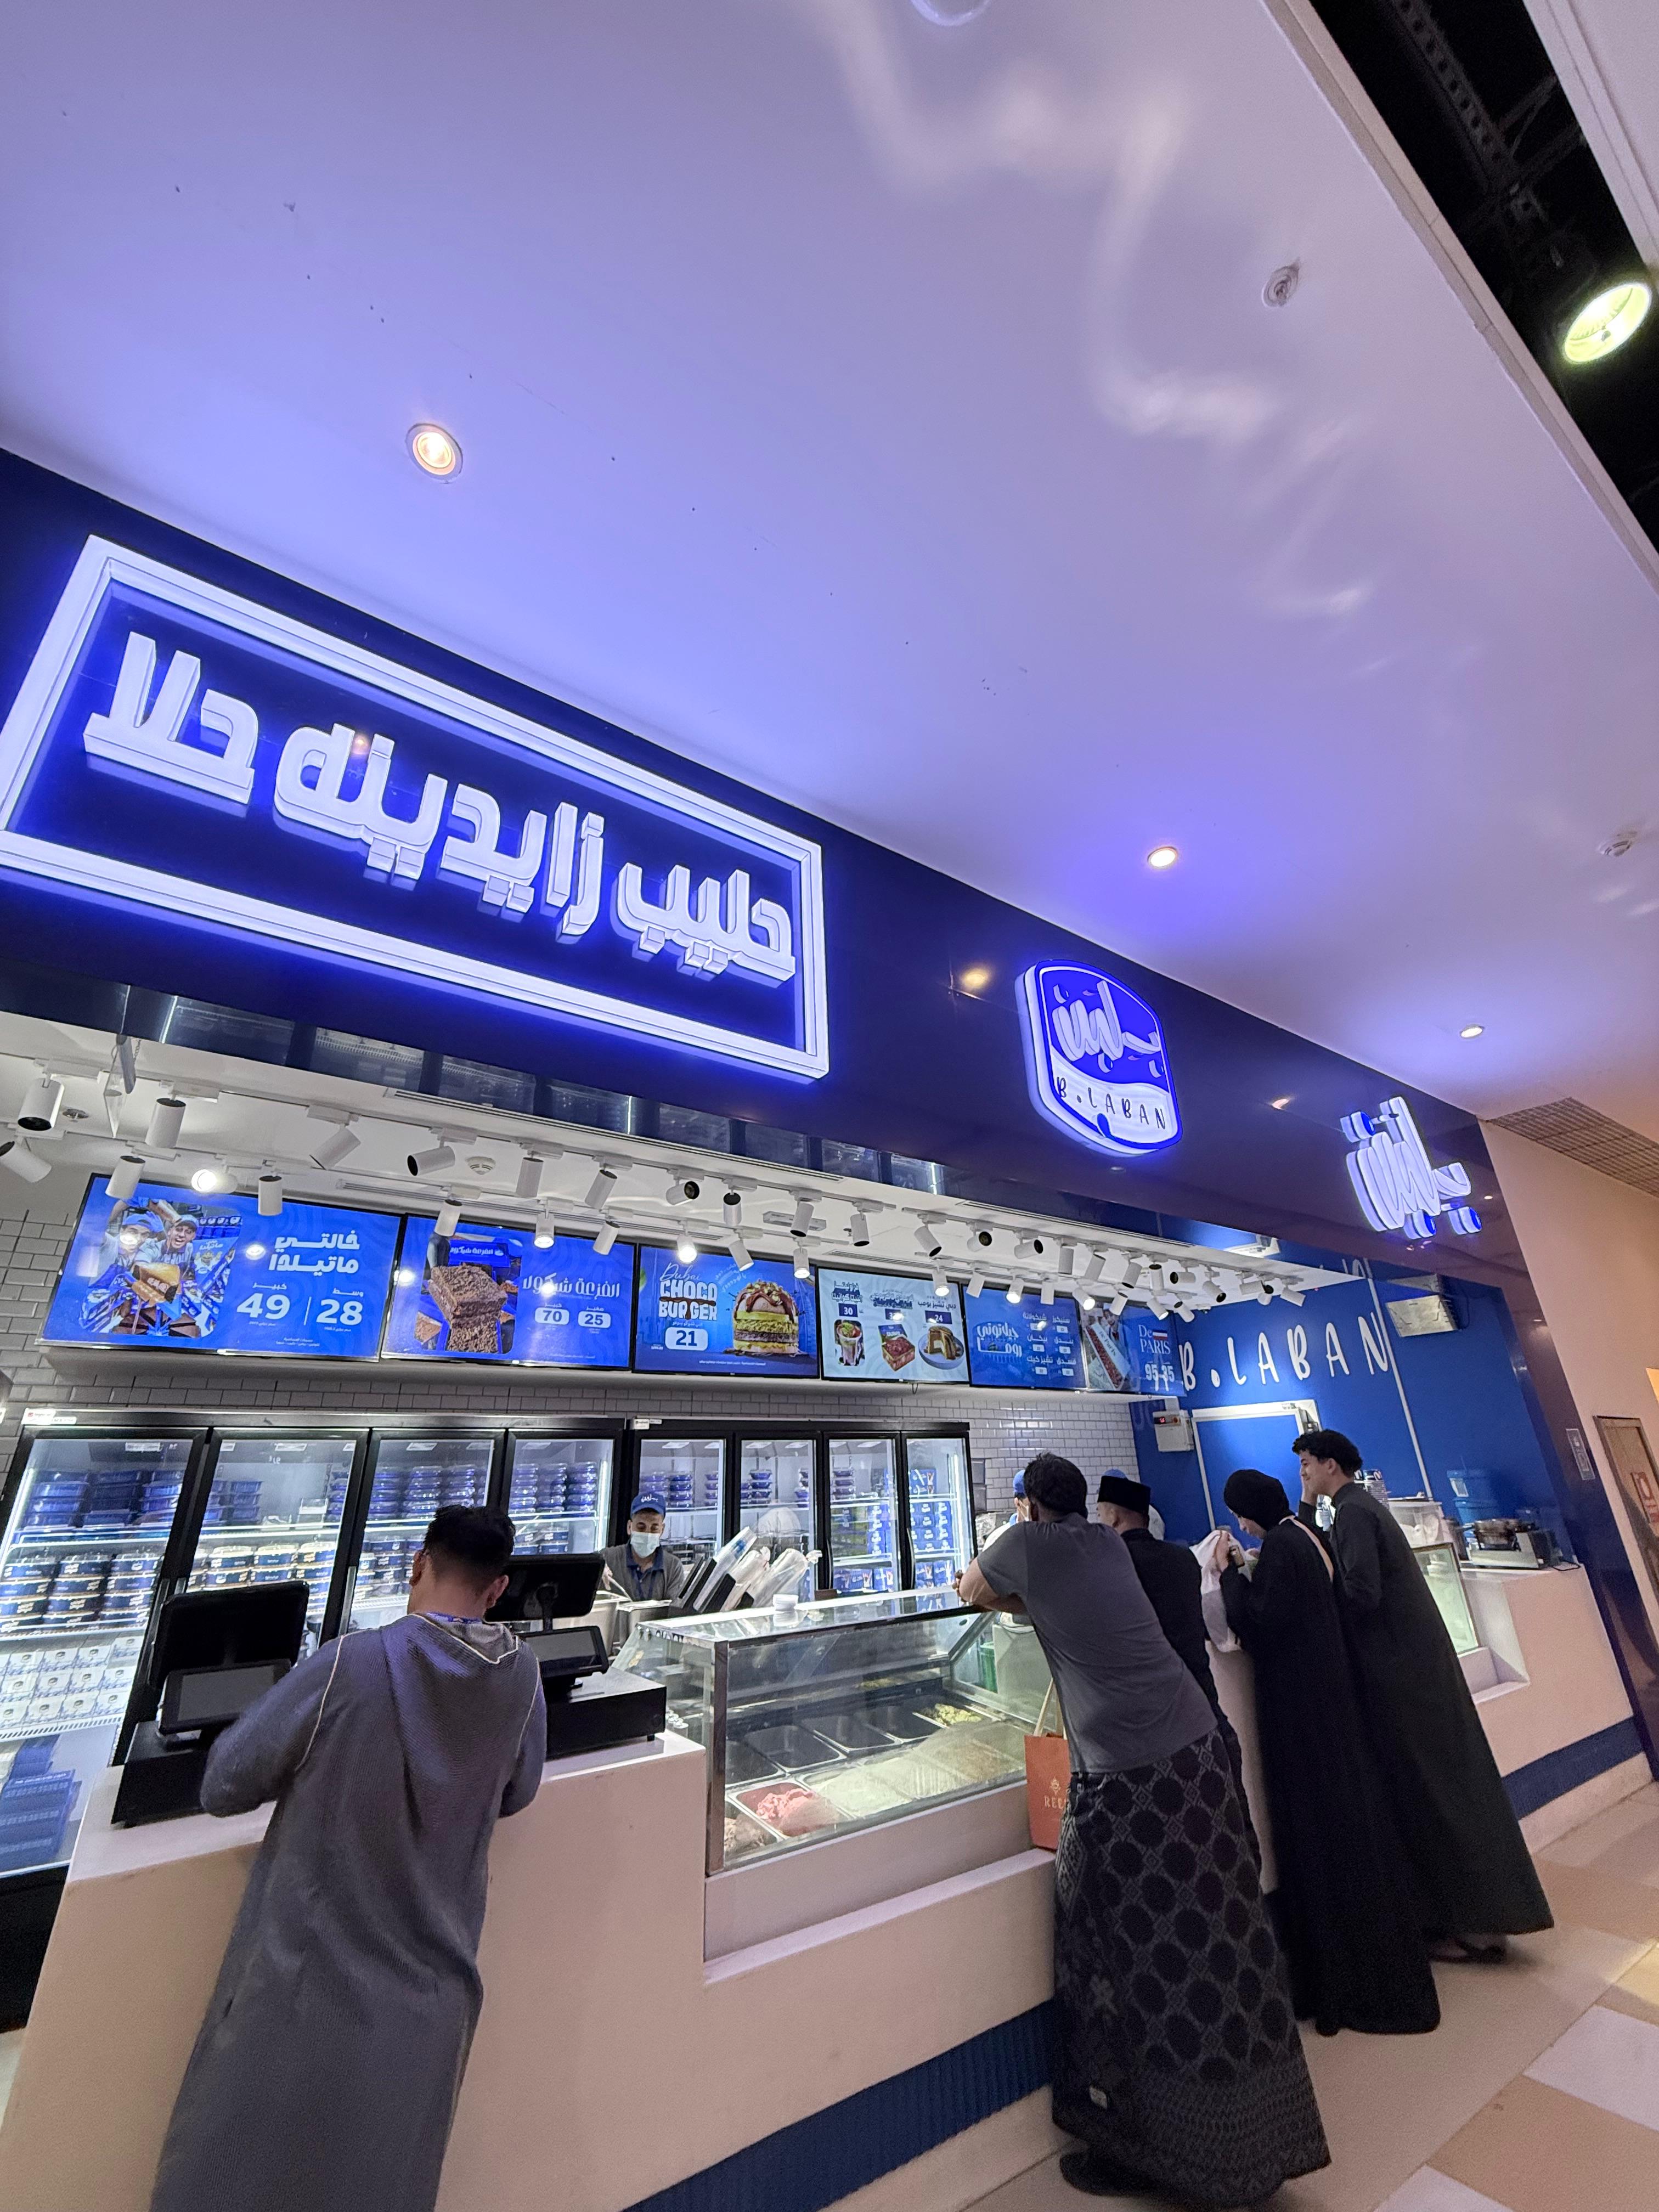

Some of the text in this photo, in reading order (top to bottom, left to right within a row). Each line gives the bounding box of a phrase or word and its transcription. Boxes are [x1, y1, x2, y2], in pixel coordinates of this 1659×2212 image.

[82, 631, 258, 804] حلا
[616, 861, 796, 981] حليب
[1056, 1076, 1166, 1130] B.LABAN
[274, 1229, 360, 1252] خالتي
[268, 1254, 359, 1277] ماتيلدا
[659, 1263, 701, 1282] Dubai
[332, 1288, 364, 1297] وسط
[575, 1278, 620, 1300] الفزعة
[659, 1279, 718, 1301] CHOCO
[236, 1293, 291, 1320] 49
[315, 1299, 363, 1326] 28
[542, 1310, 562, 1322] 70
[658, 1301, 718, 1321] BURGER
[843, 1307, 853, 1316] 30
[584, 1313, 603, 1326] 25
[934, 1314, 943, 1322] 24
[675, 1330, 698, 1347] 21
[1138, 1324, 1153, 1338] De
[977, 1336, 1023, 1358] روما
[1140, 1338, 1171, 1355] PARIS
[1178, 1311, 1389, 1391] B.LABAN
[1144, 1363, 1159, 1381] 95
[1044, 1795, 1066, 1809] REE
